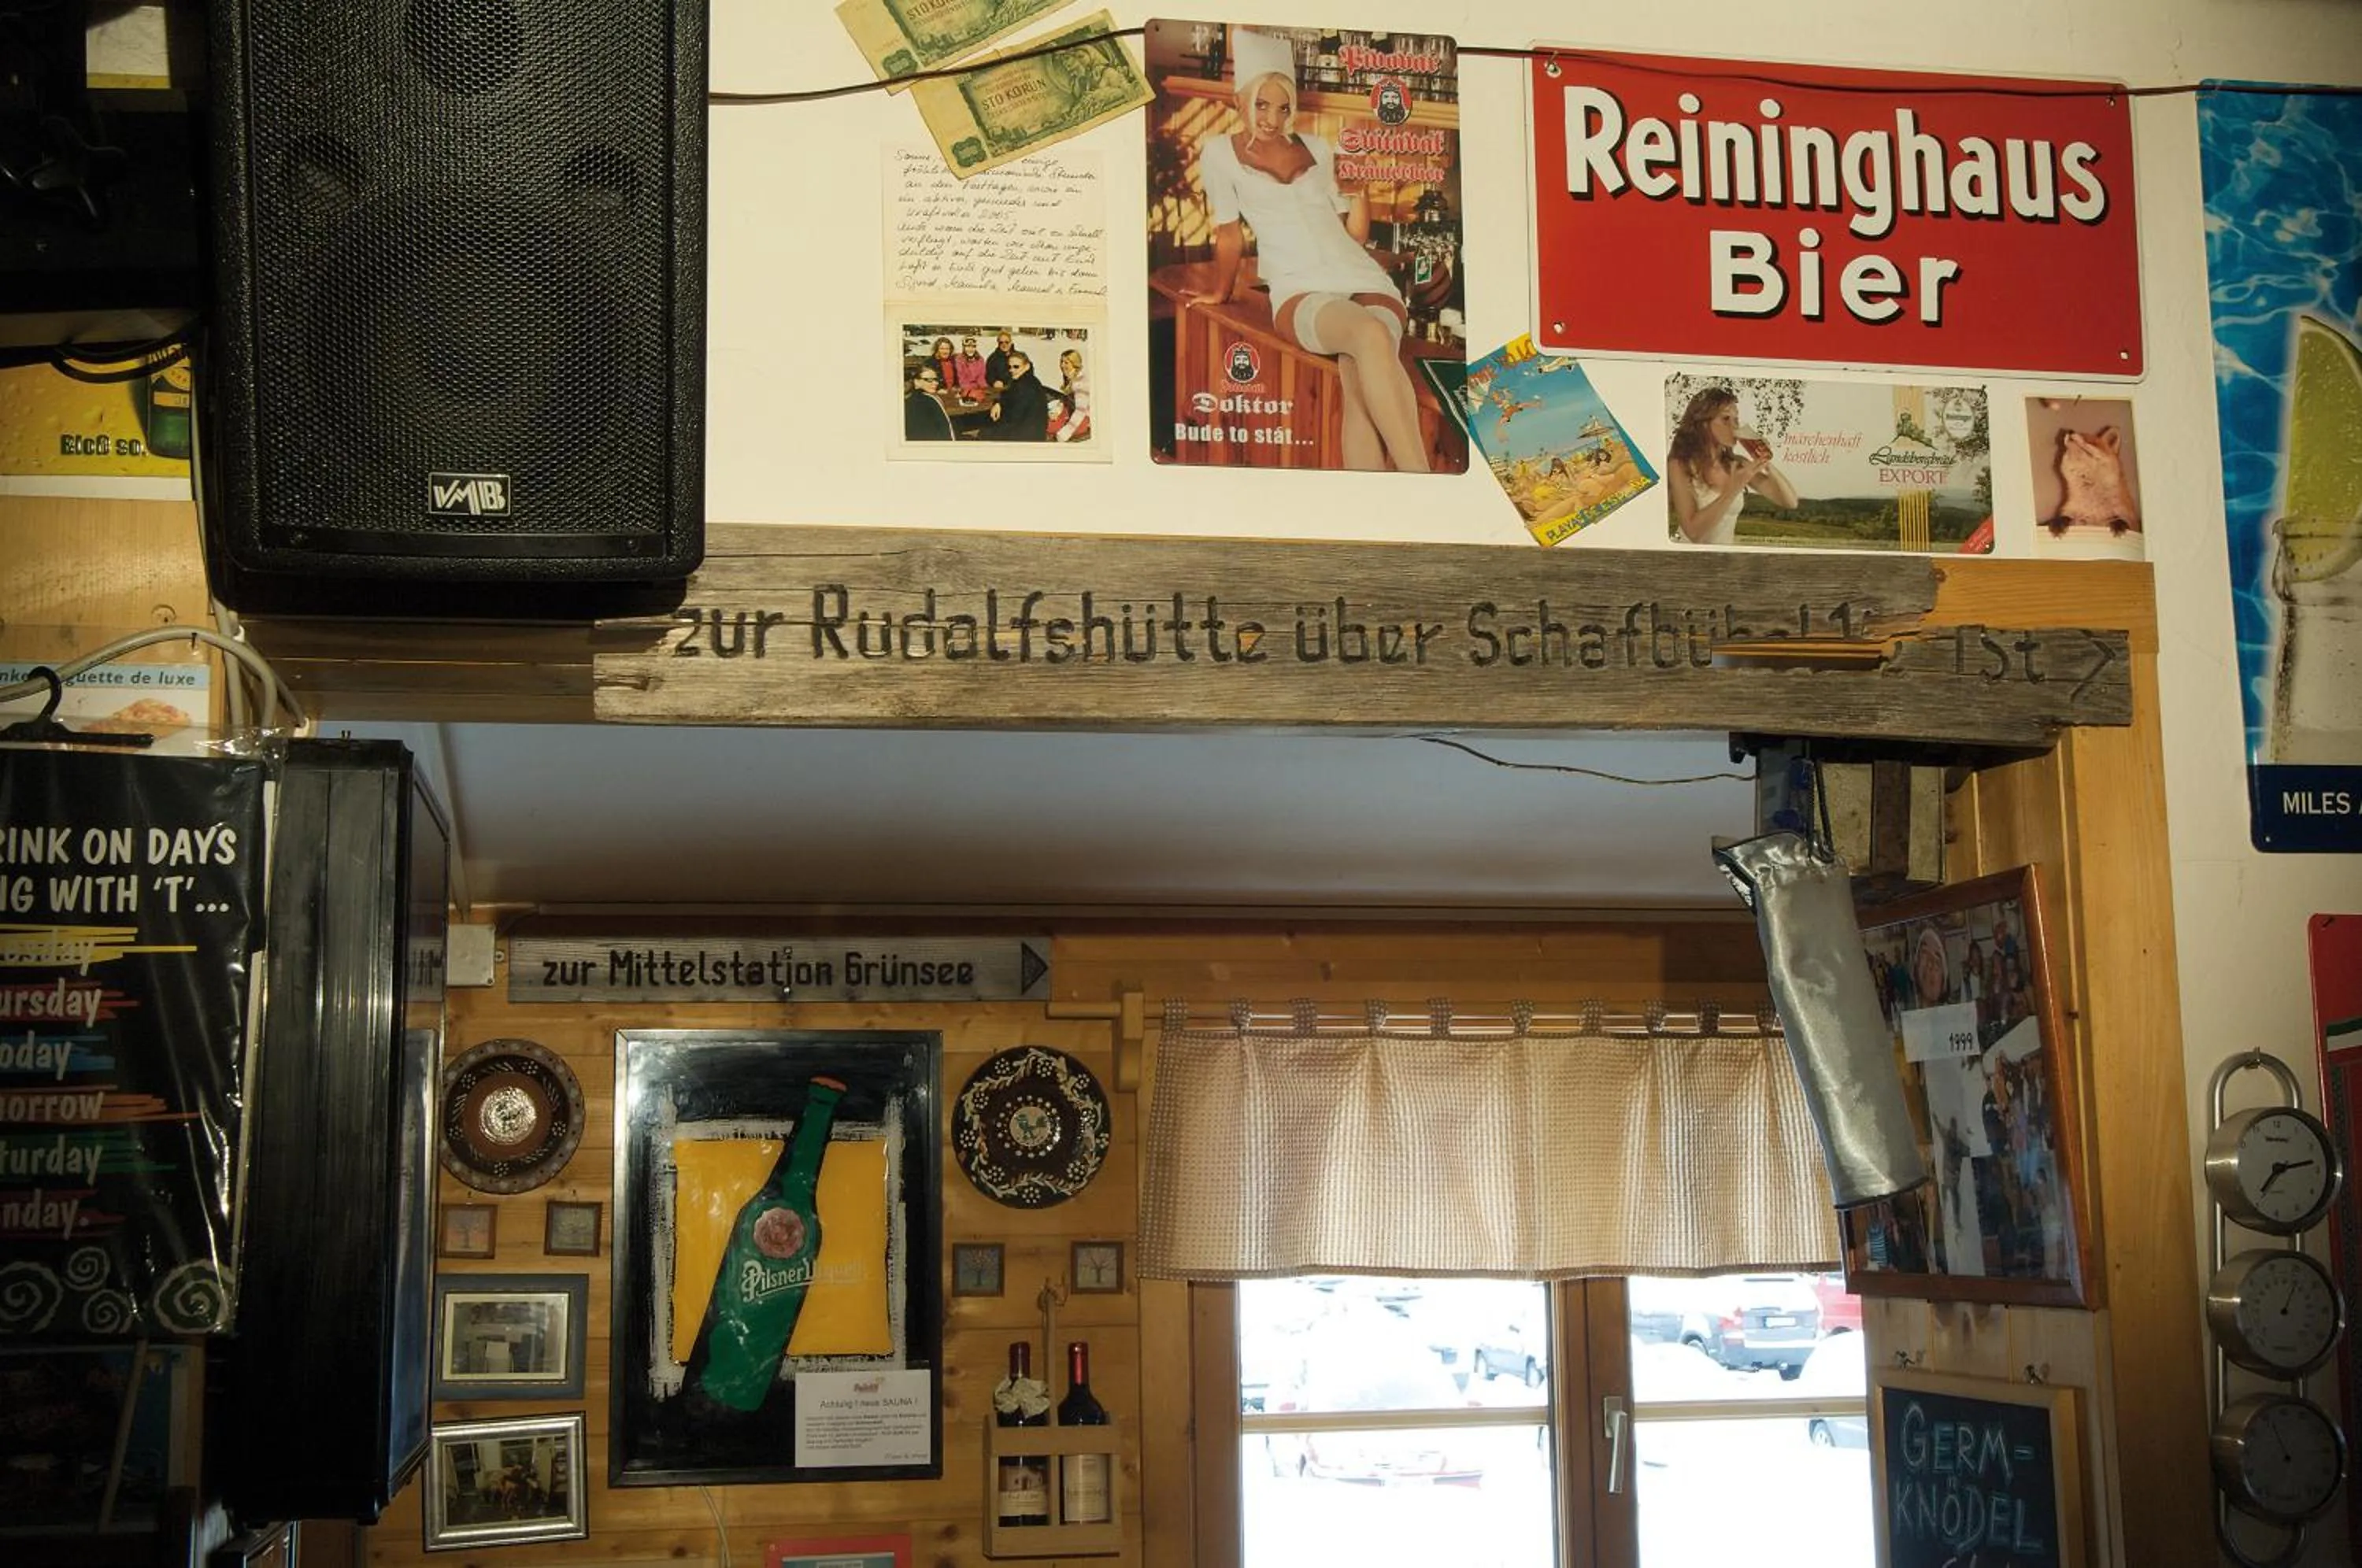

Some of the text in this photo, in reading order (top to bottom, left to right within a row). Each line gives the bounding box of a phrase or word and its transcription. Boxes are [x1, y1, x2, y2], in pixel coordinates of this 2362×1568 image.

[1005, 77, 1047, 101] KORUN
[1564, 85, 2110, 236] Reininghaus
[1709, 227, 1961, 326] Bier
[1191, 392, 1294, 414] Doktor
[1175, 423, 1224, 442] Bude
[1230, 426, 1249, 442] to
[1879, 468, 1947, 484] EXPORT
[671, 608, 784, 660] zur
[1294, 595, 1444, 665] über
[131, 671, 152, 685] de
[158, 671, 196, 686] luxe
[2282, 791, 2351, 815] MILES
[82, 827, 132, 865] ON
[147, 825, 237, 866] DAYS
[50, 875, 139, 913] WITH
[542, 949, 975, 988] zur Mittelstation Grünsee
[1949, 1032, 1974, 1052] 1999
[742, 1259, 804, 1303] Pilsner
